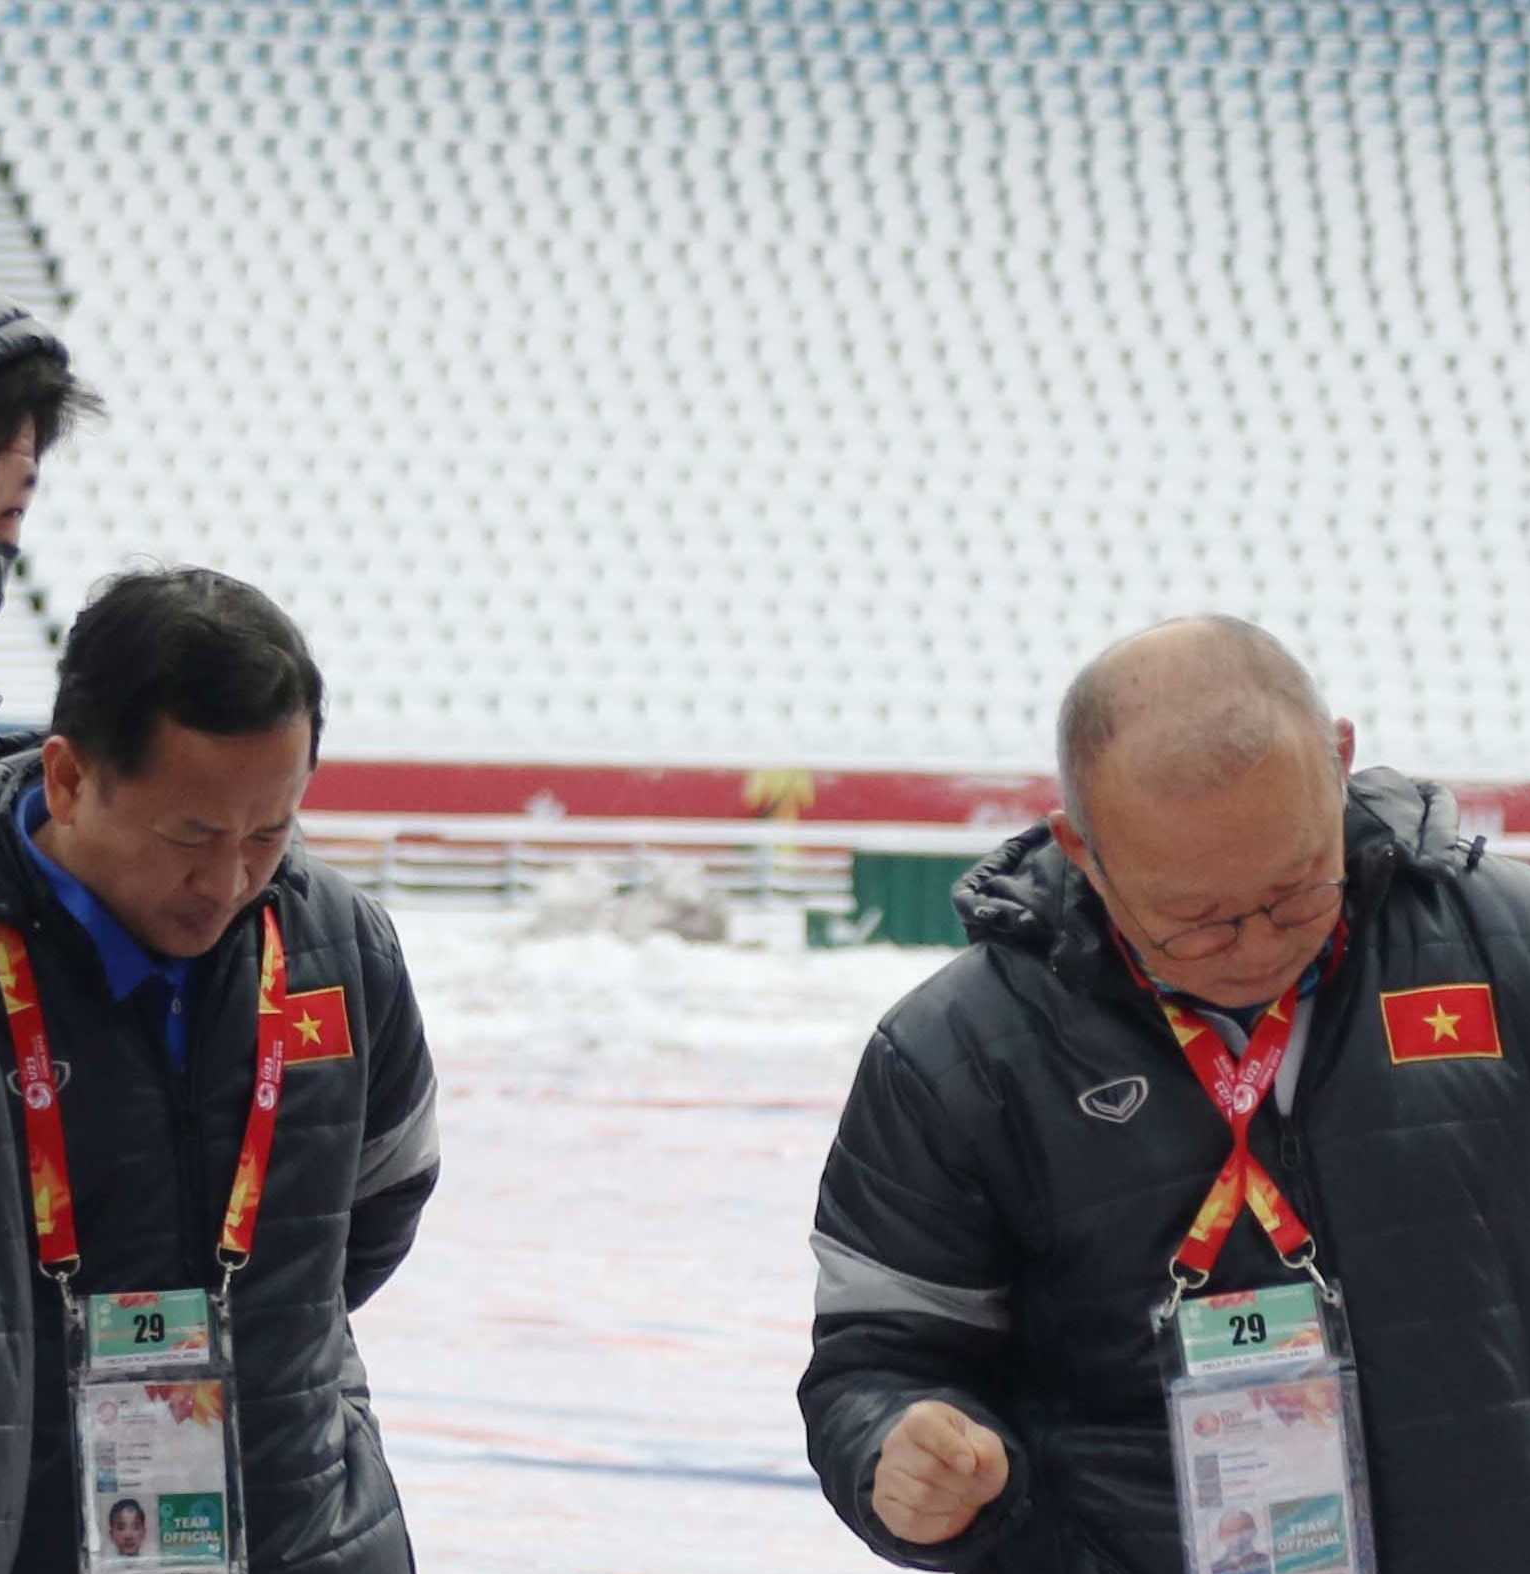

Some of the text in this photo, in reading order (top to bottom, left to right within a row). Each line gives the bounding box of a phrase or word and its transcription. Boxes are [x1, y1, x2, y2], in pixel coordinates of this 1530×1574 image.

[133, 1312, 166, 1344] 29
[1229, 1313, 1267, 1346] 29
[172, 1516, 211, 1530] TEAM
[162, 1530, 222, 1545] OFFICIAL
[1276, 1531, 1341, 1553] OFFICIAL
